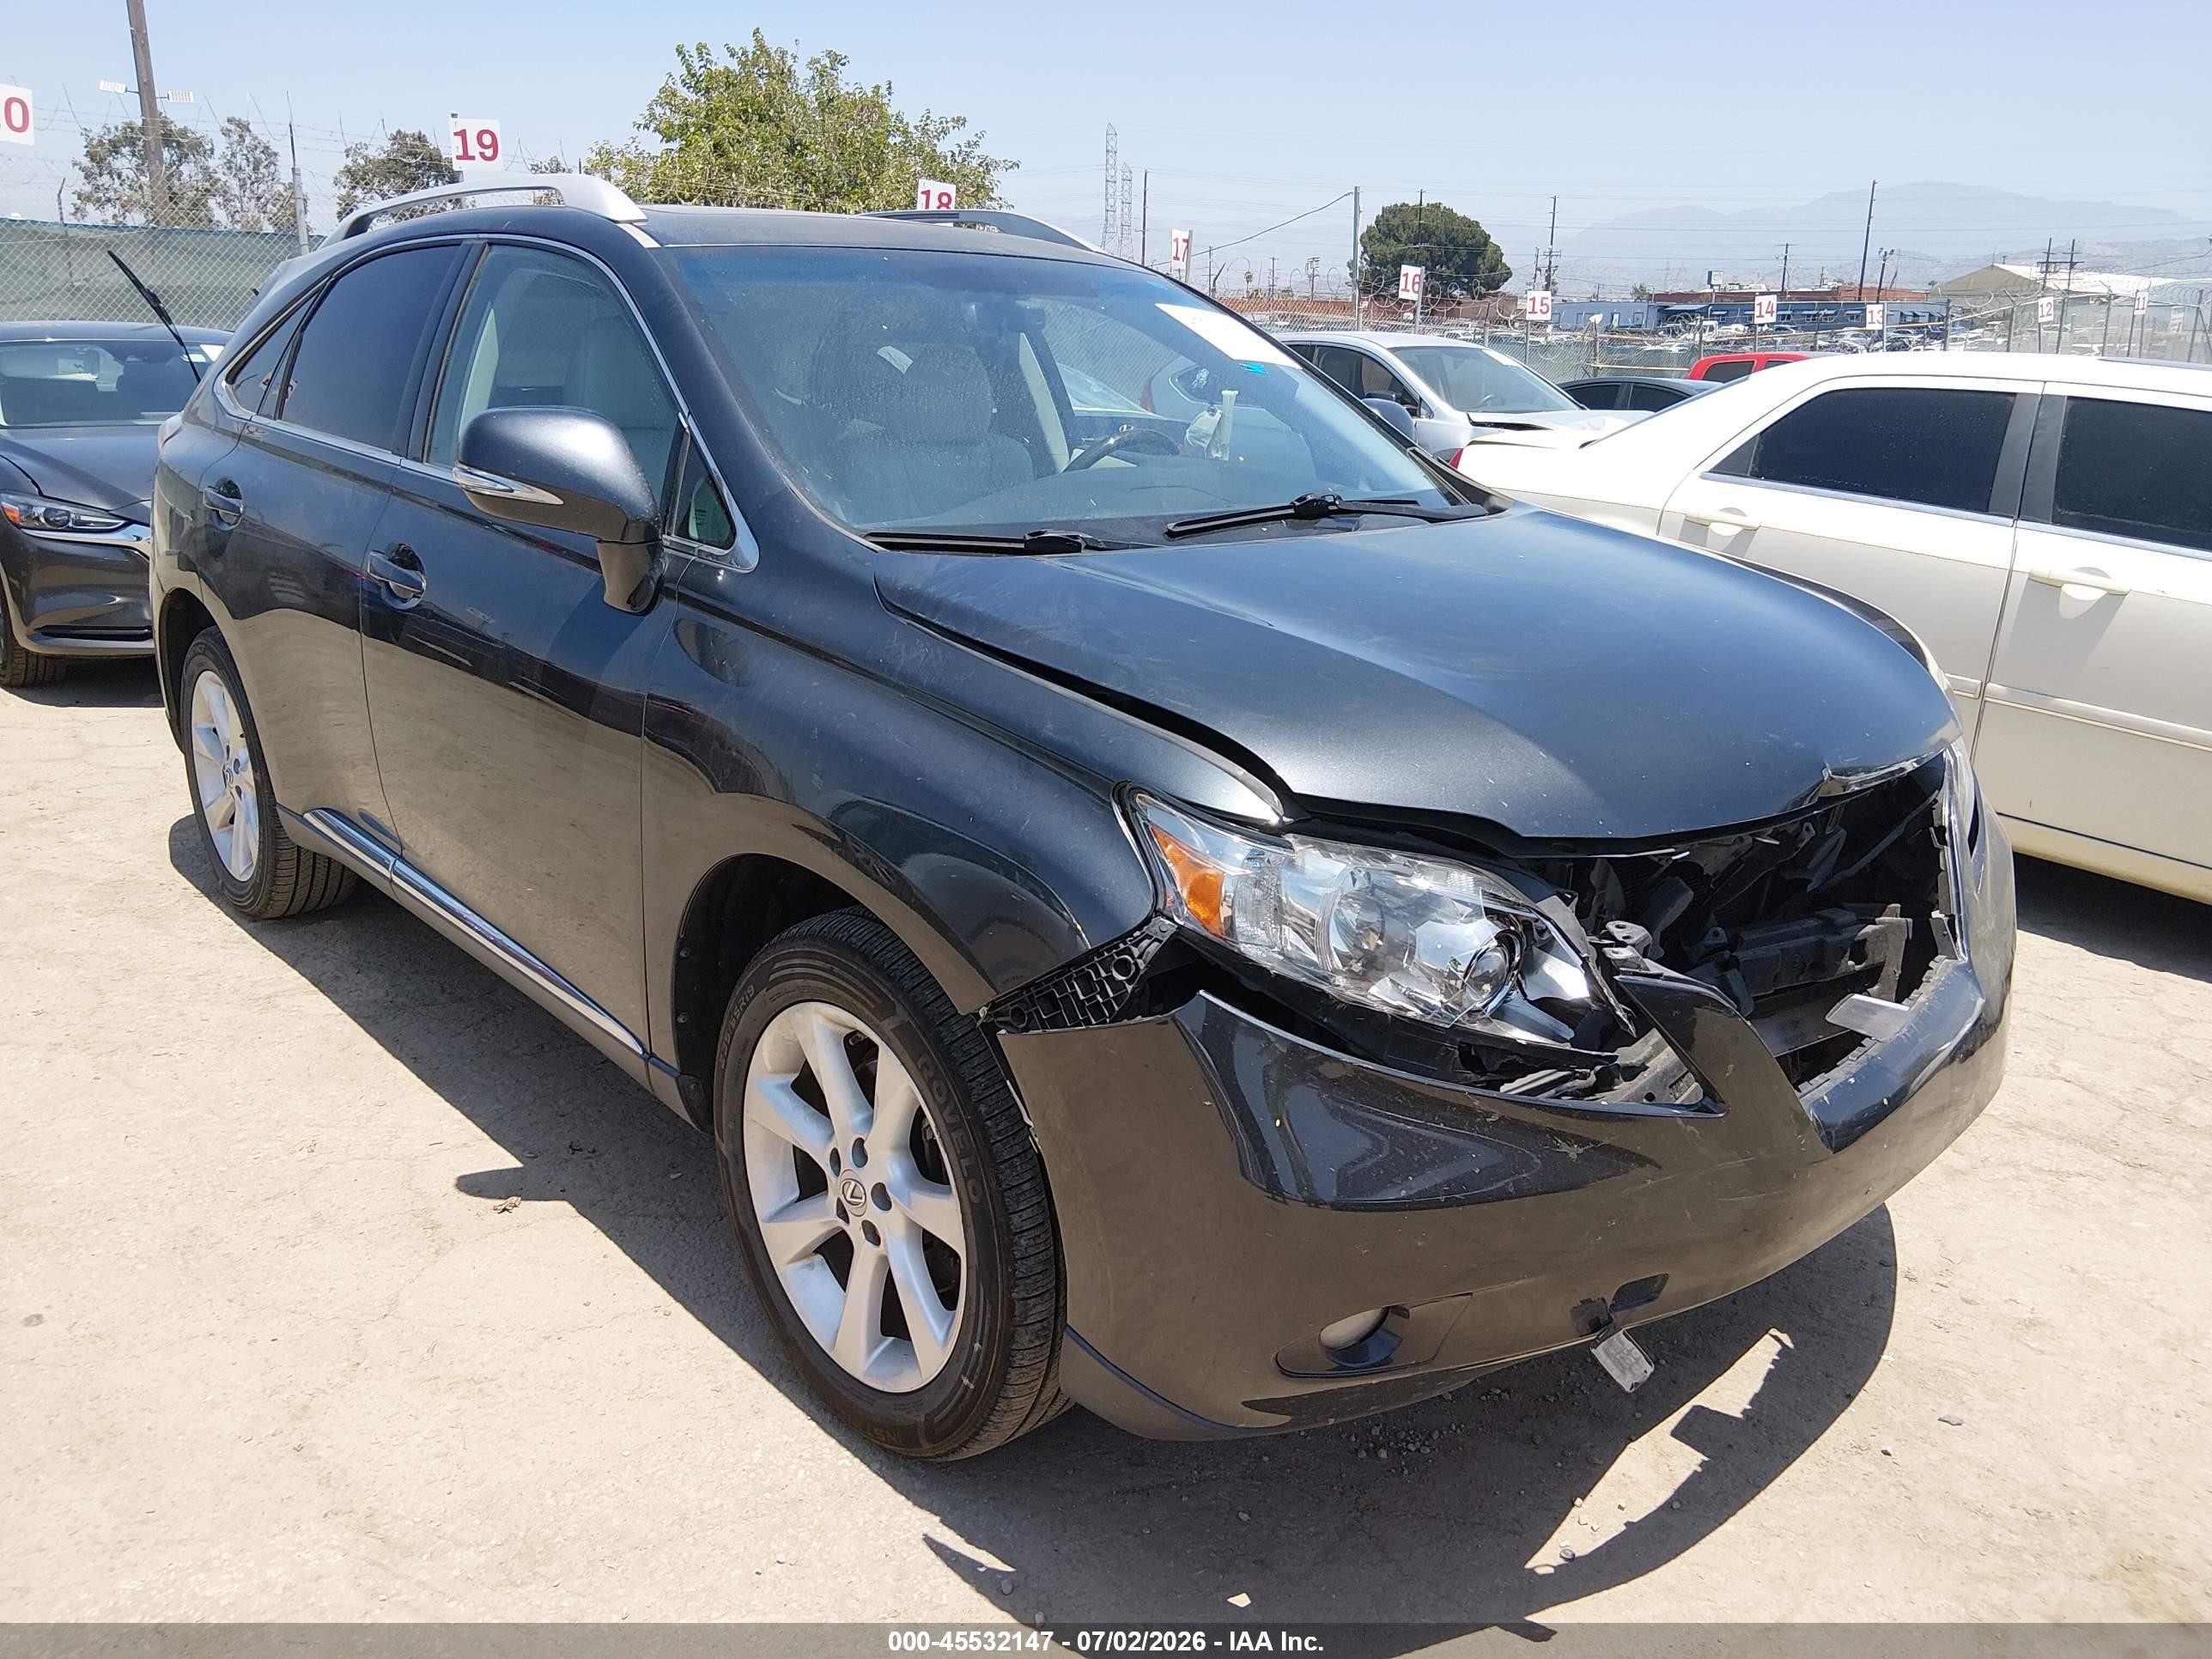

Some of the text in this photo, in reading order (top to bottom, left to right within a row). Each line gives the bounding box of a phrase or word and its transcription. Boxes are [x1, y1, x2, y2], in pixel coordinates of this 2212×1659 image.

[0, 98, 29, 133] 0
[454, 129, 499, 161] 19
[921, 189, 953, 210] 18
[1172, 237, 1194, 262] 17
[1401, 272, 1421, 294] 16
[1528, 296, 1550, 315] 15
[1756, 301, 1776, 319] 14
[2039, 301, 2053, 318] 12
[2135, 296, 2146, 311] 11
[1868, 309, 1883, 325] 13
[916, 1053, 984, 1204] ROVELO
